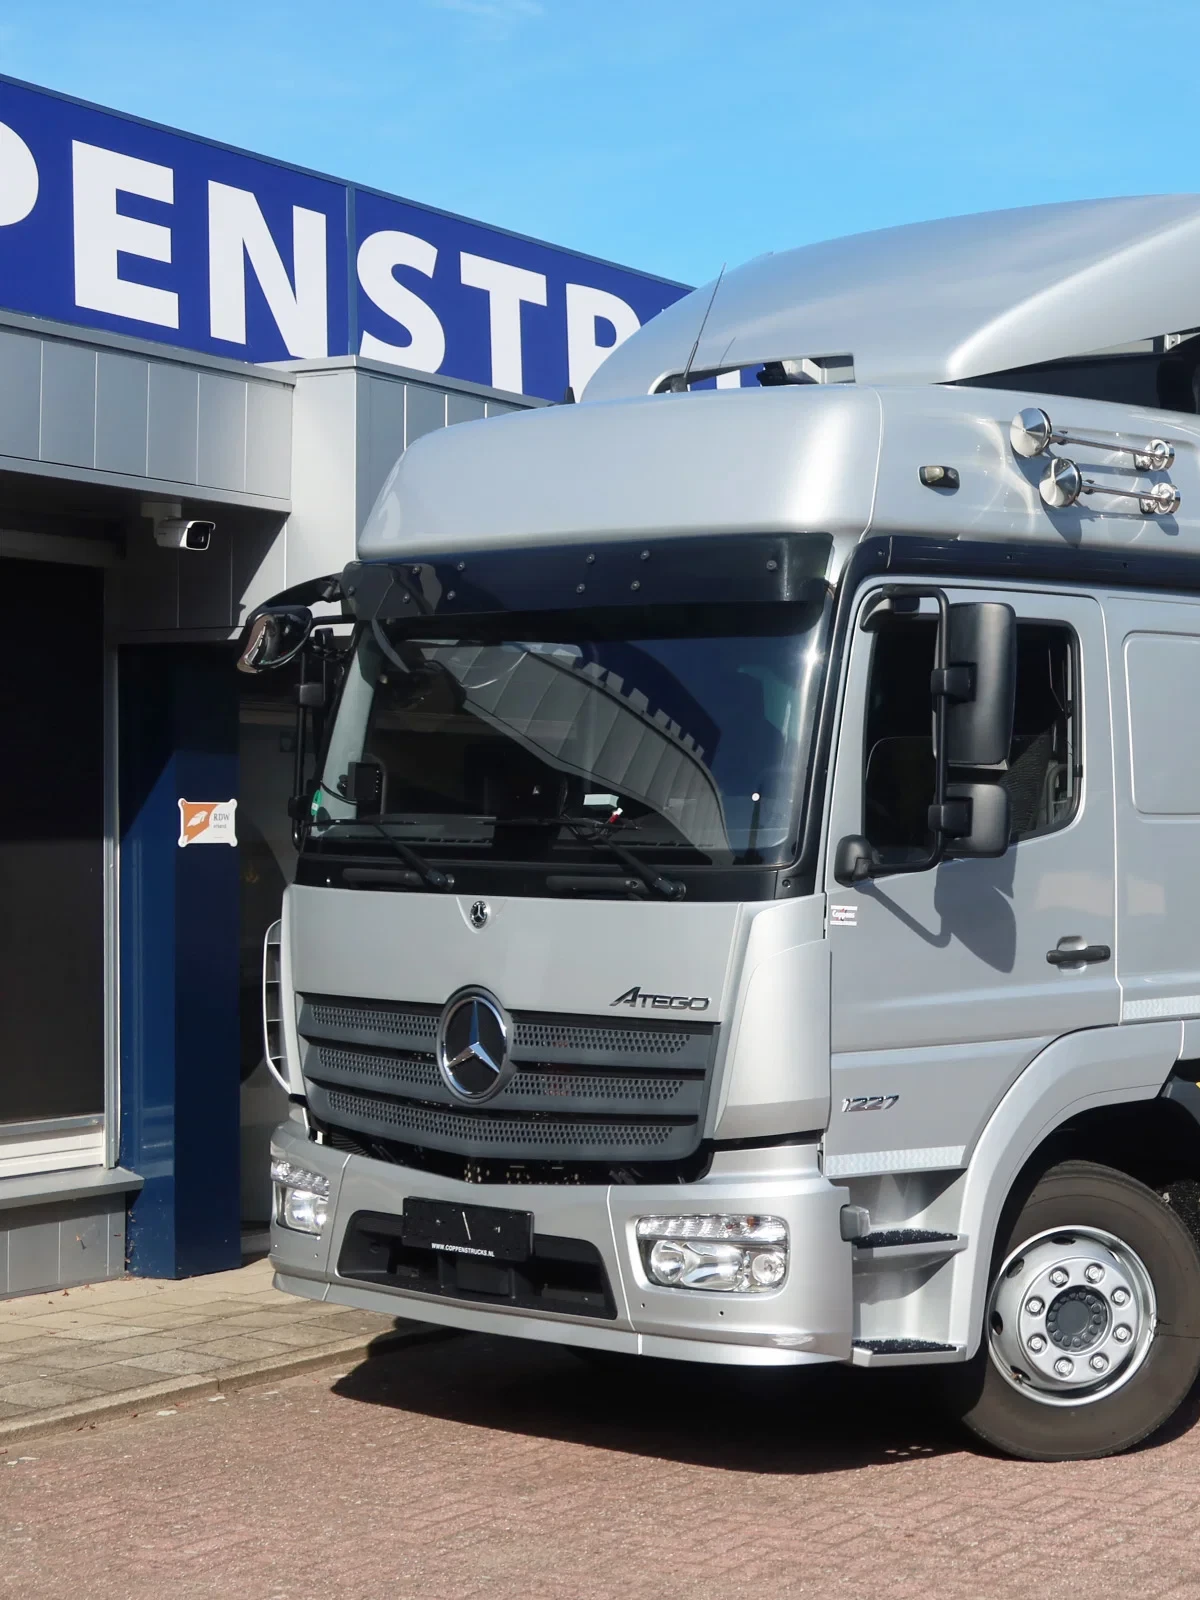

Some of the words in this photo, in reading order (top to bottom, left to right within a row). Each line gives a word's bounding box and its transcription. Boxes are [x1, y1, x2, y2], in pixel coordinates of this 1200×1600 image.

[213, 813, 231, 822] RDW
[609, 986, 711, 1012] ATEGO
[841, 1094, 900, 1113] 1227
[431, 1242, 496, 1258] WWW.COPPENSTRUCKS.NL
